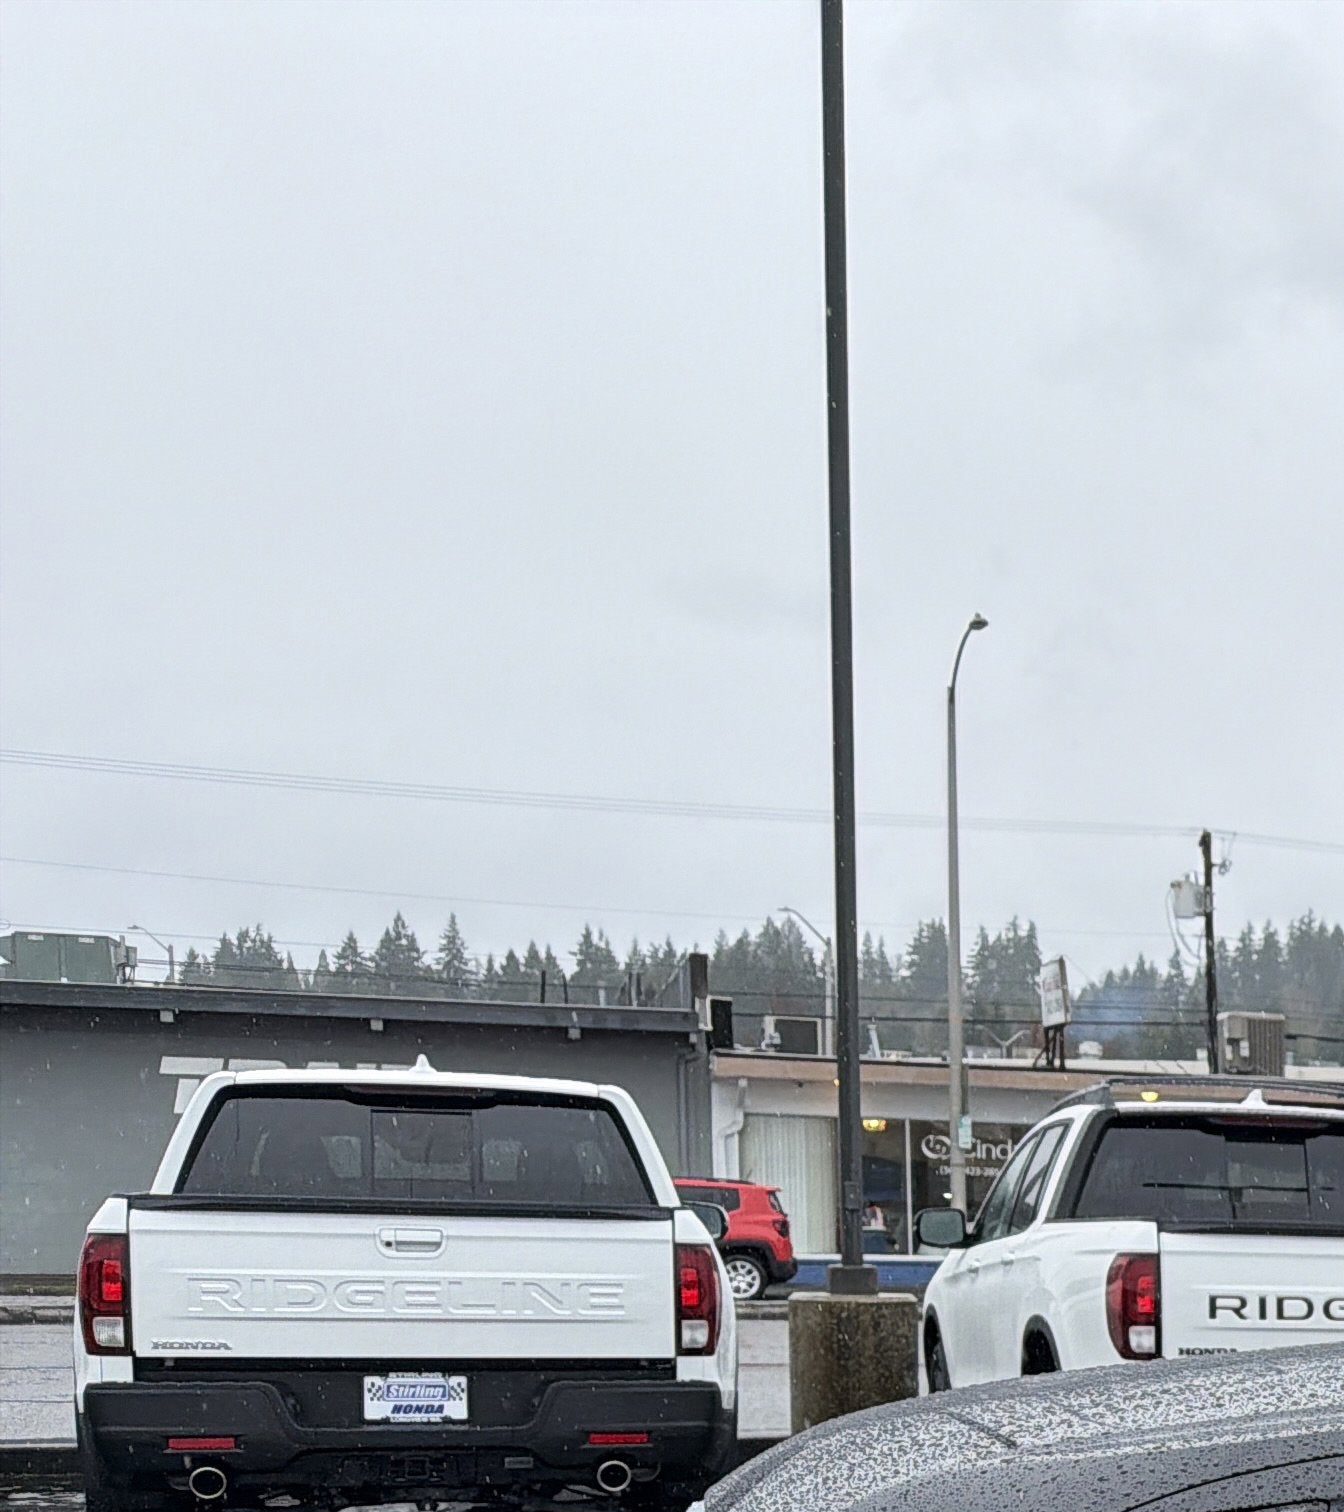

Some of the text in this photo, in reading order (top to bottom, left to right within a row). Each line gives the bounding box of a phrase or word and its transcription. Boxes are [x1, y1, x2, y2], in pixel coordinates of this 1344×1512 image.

[187, 1277, 626, 1315] RIDGELINE
[151, 1340, 232, 1350] HONDA
[388, 1384, 443, 1400] Stirling
[391, 1403, 445, 1415] HONDA
